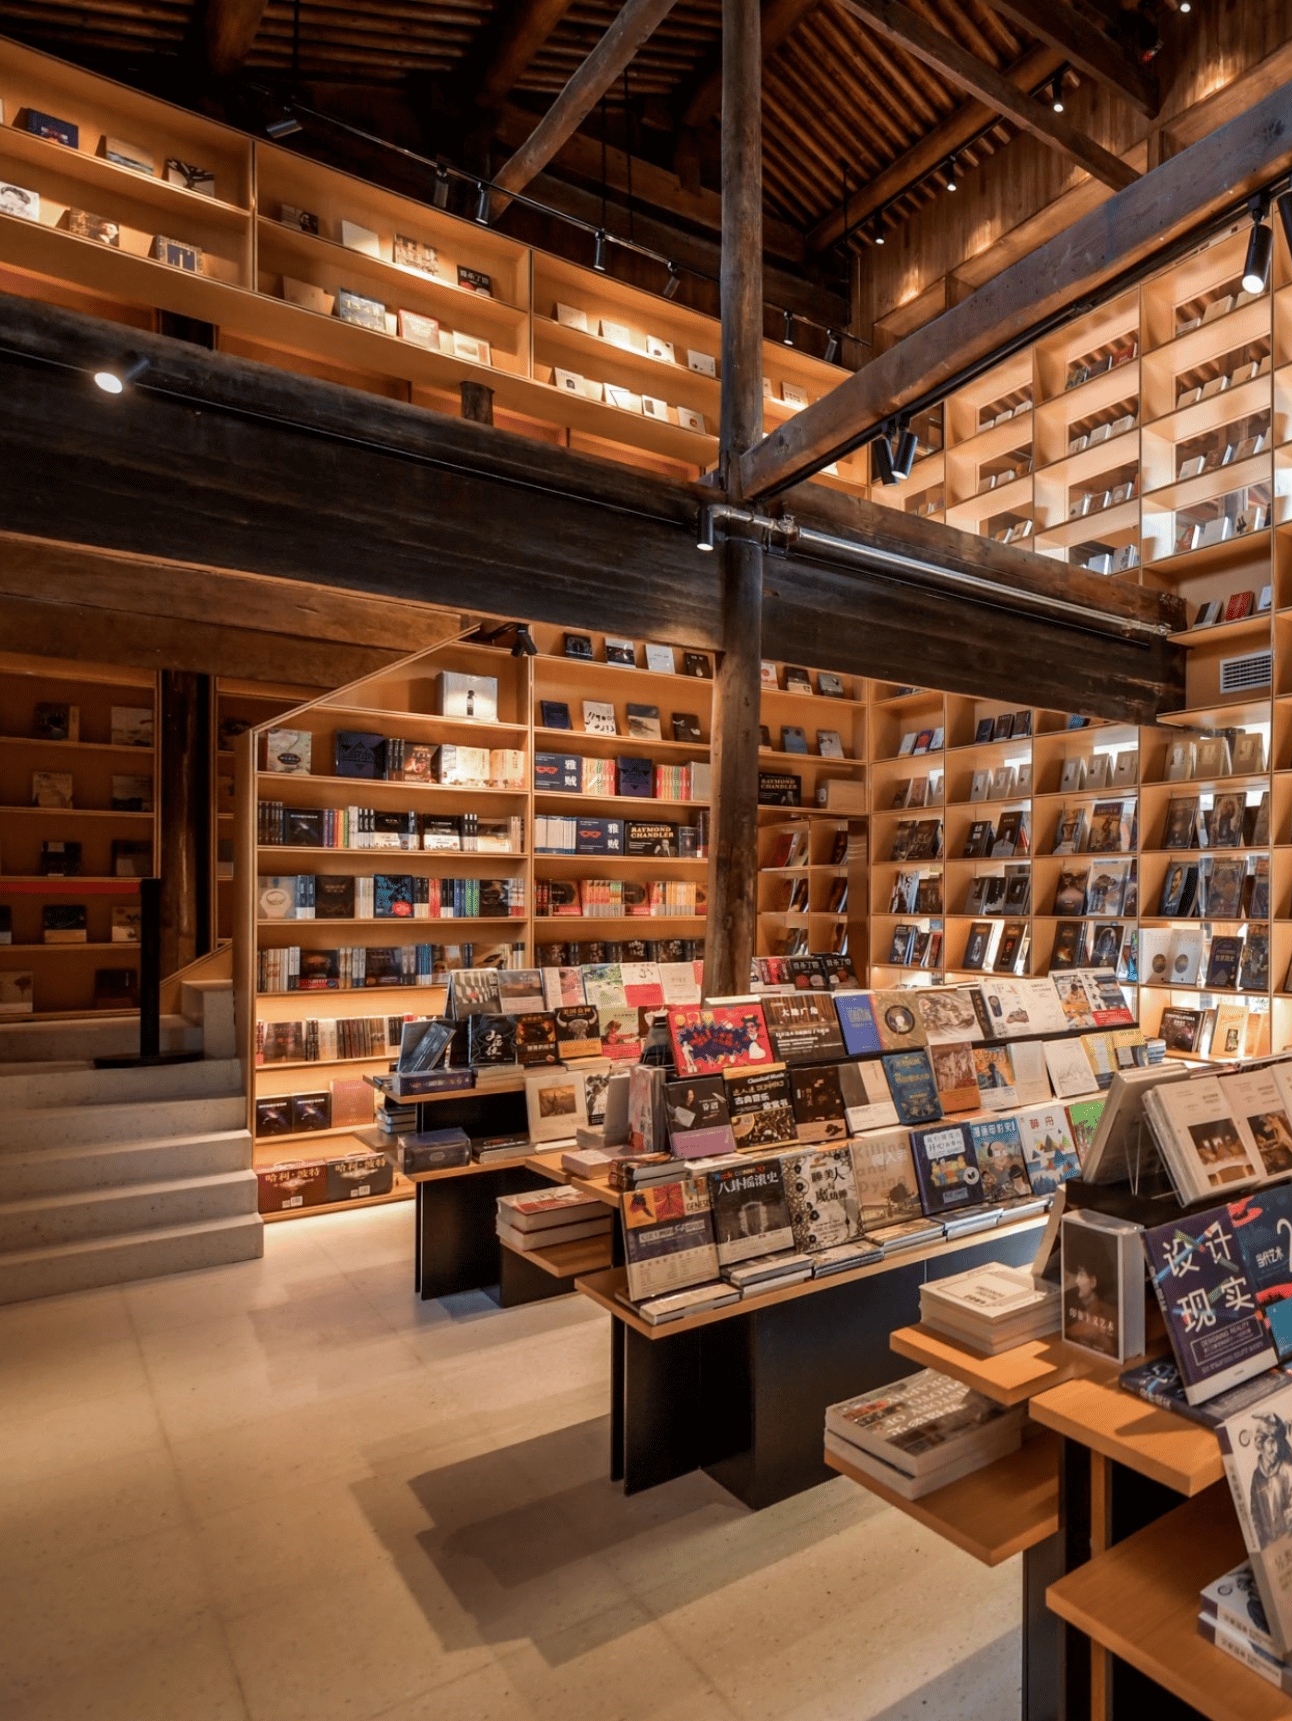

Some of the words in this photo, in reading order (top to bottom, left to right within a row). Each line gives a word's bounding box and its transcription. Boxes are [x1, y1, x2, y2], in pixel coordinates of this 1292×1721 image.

[265, 1167, 320, 1182] 哈利·波特
[335, 1158, 386, 1172] 哈利·波特
[1163, 1219, 1233, 1278] 设计
[1177, 1276, 1255, 1333] 现实
